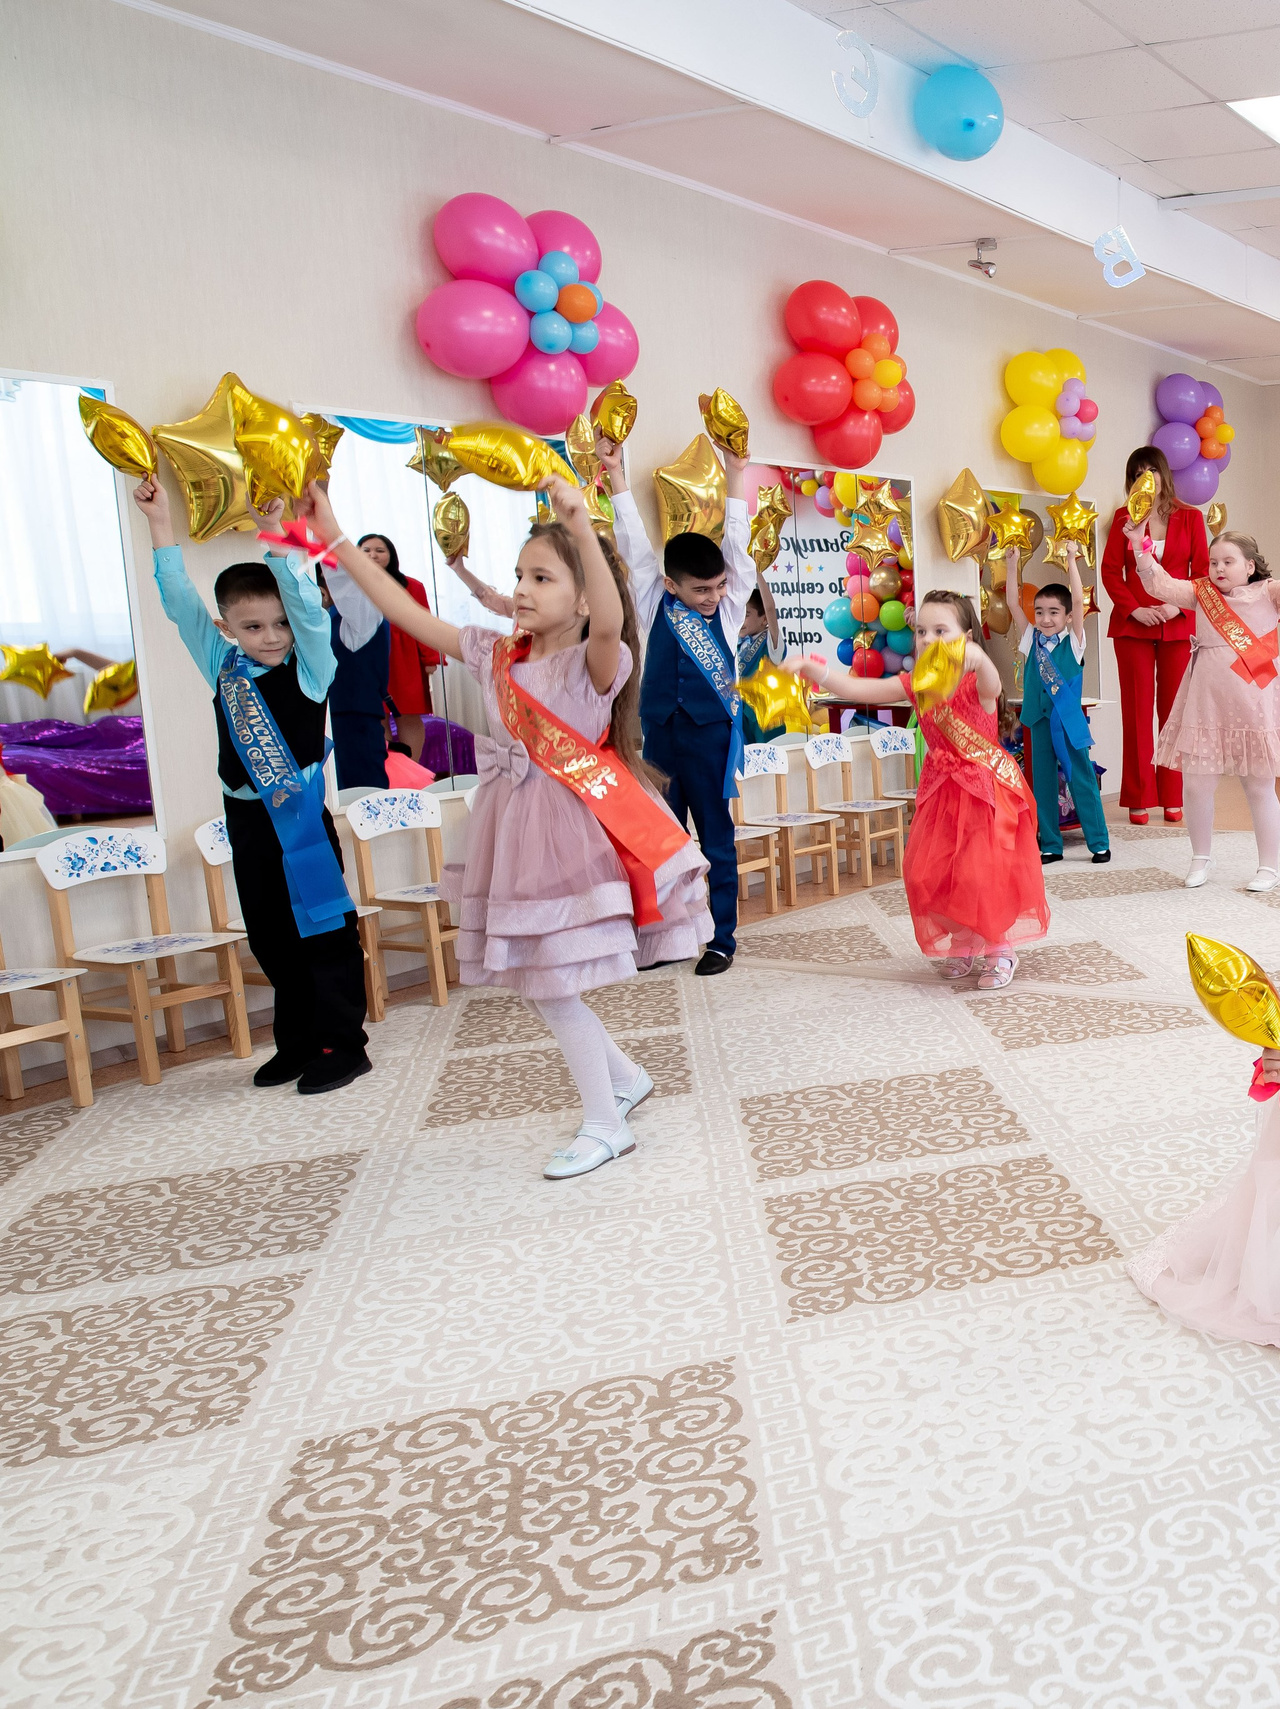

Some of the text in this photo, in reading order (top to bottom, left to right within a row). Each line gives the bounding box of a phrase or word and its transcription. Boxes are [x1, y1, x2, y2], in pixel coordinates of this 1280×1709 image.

[220, 681, 276, 788] ДЕТСКОГО САДА
[233, 676, 292, 785] Выпускник
